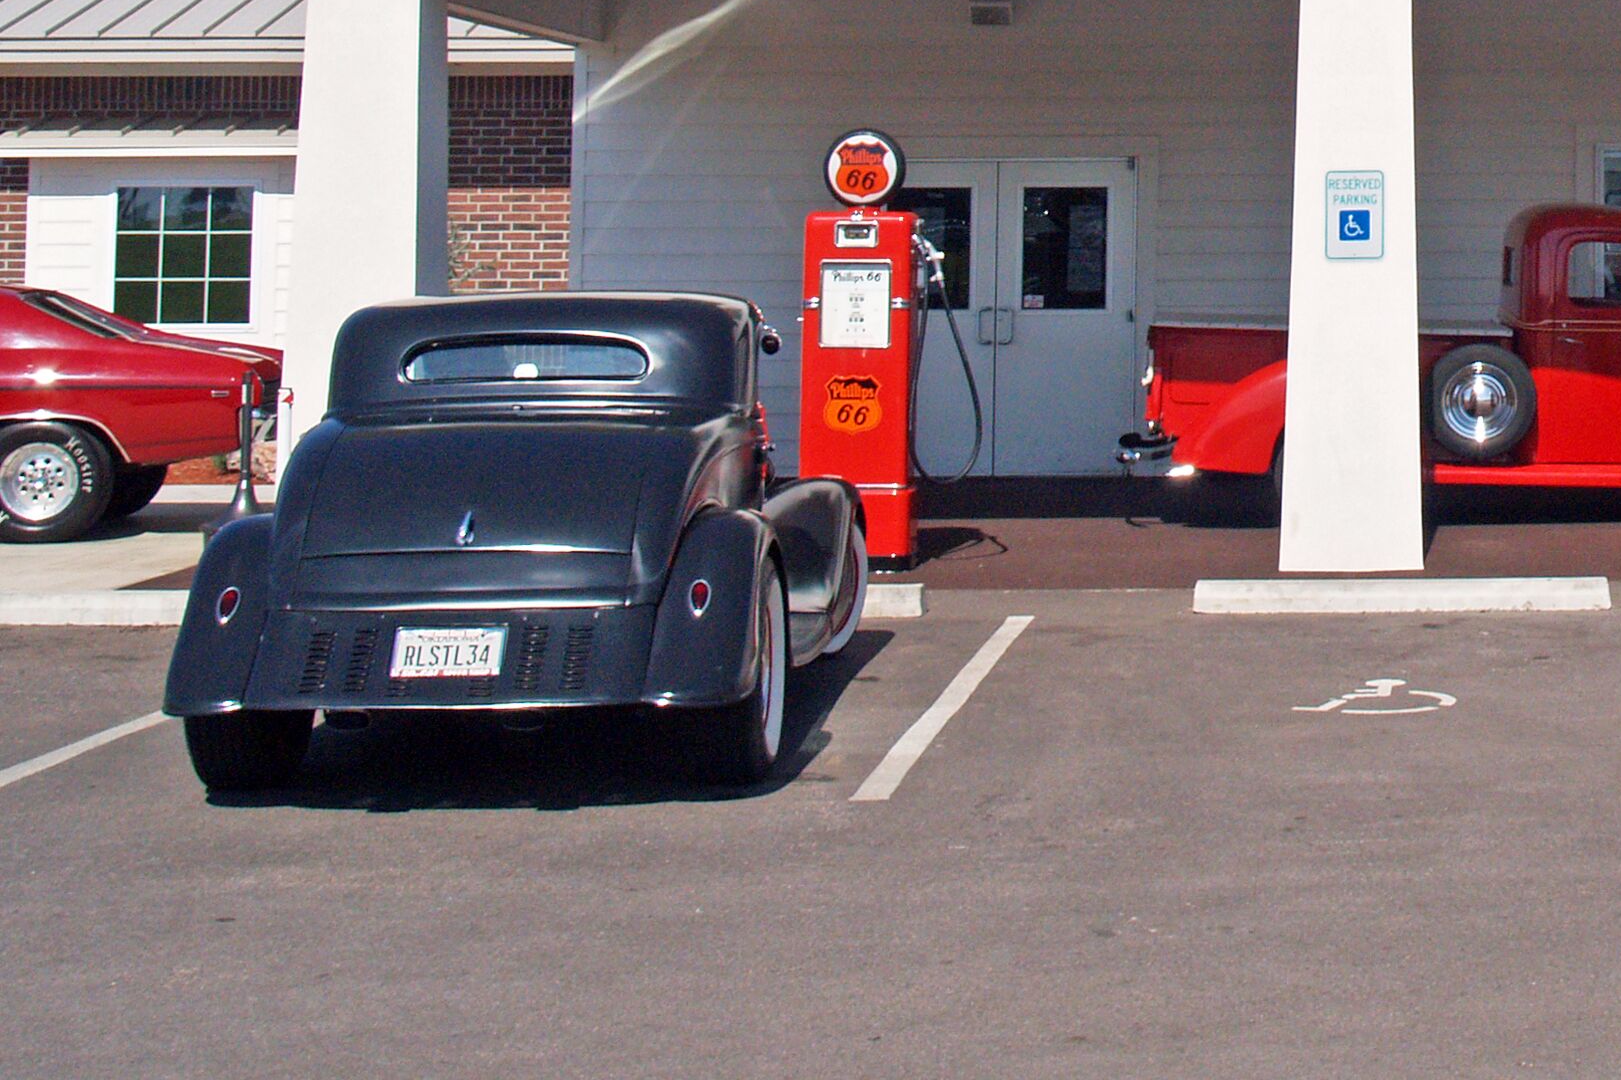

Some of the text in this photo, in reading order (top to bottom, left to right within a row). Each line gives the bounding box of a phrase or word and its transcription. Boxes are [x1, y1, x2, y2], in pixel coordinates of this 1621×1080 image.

[846, 168, 877, 190] 66
[1327, 178, 1381, 190] RESERVED
[1332, 193, 1378, 205] PARKING
[866, 271, 882, 282] 66
[830, 381, 875, 402] Phillips
[836, 403, 869, 426] 66
[403, 644, 492, 667] RLSTL34
